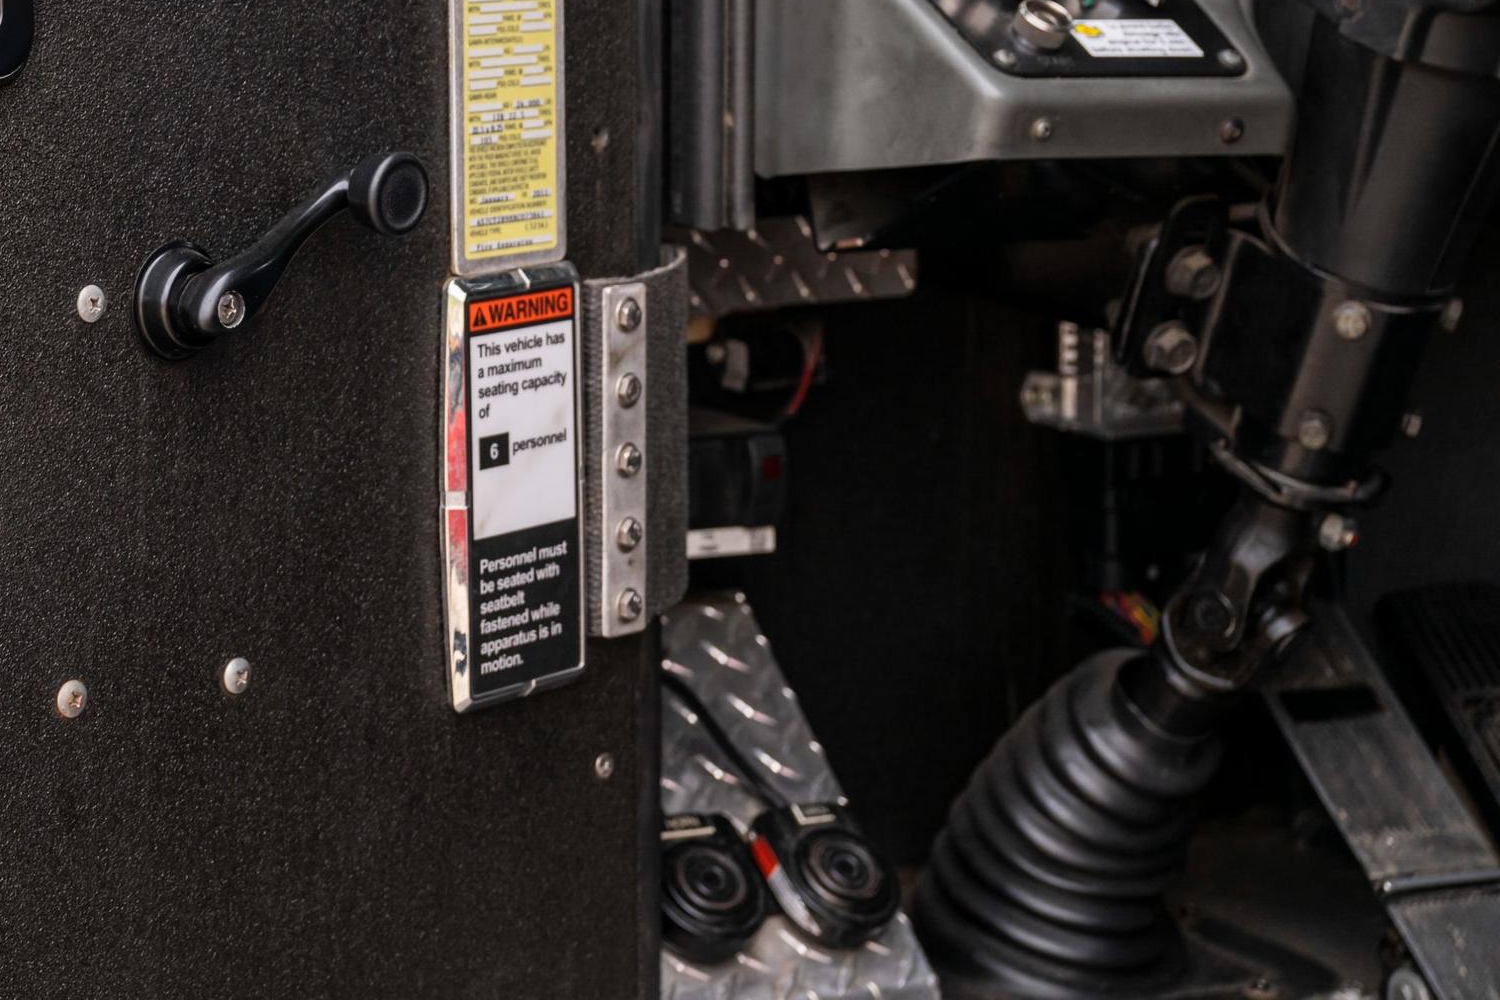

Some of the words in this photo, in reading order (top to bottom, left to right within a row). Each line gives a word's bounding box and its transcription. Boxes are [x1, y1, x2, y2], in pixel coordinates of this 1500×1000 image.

[488, 292, 569, 324] WARNING
[477, 342, 501, 358] This
[504, 335, 543, 354] vehicle
[546, 331, 565, 346] has
[478, 367, 484, 379] a
[487, 356, 542, 376] maximum
[478, 378, 518, 399] seating
[521, 370, 567, 392] capacity
[479, 403, 490, 419] of
[490, 442, 499, 460] 6
[512, 429, 567, 455] personnel
[480, 547, 537, 575] Personnel
[539, 540, 568, 559] must
[480, 579, 495, 595] be
[497, 568, 534, 591] seated
[536, 562, 560, 581] with
[480, 590, 525, 615] seatbelt
[480, 608, 529, 635] fastened
[531, 602, 561, 621] while
[480, 628, 537, 656] apparatus
[539, 624, 549, 640] is
[551, 621, 562, 636] in
[481, 652, 524, 675] motion.
